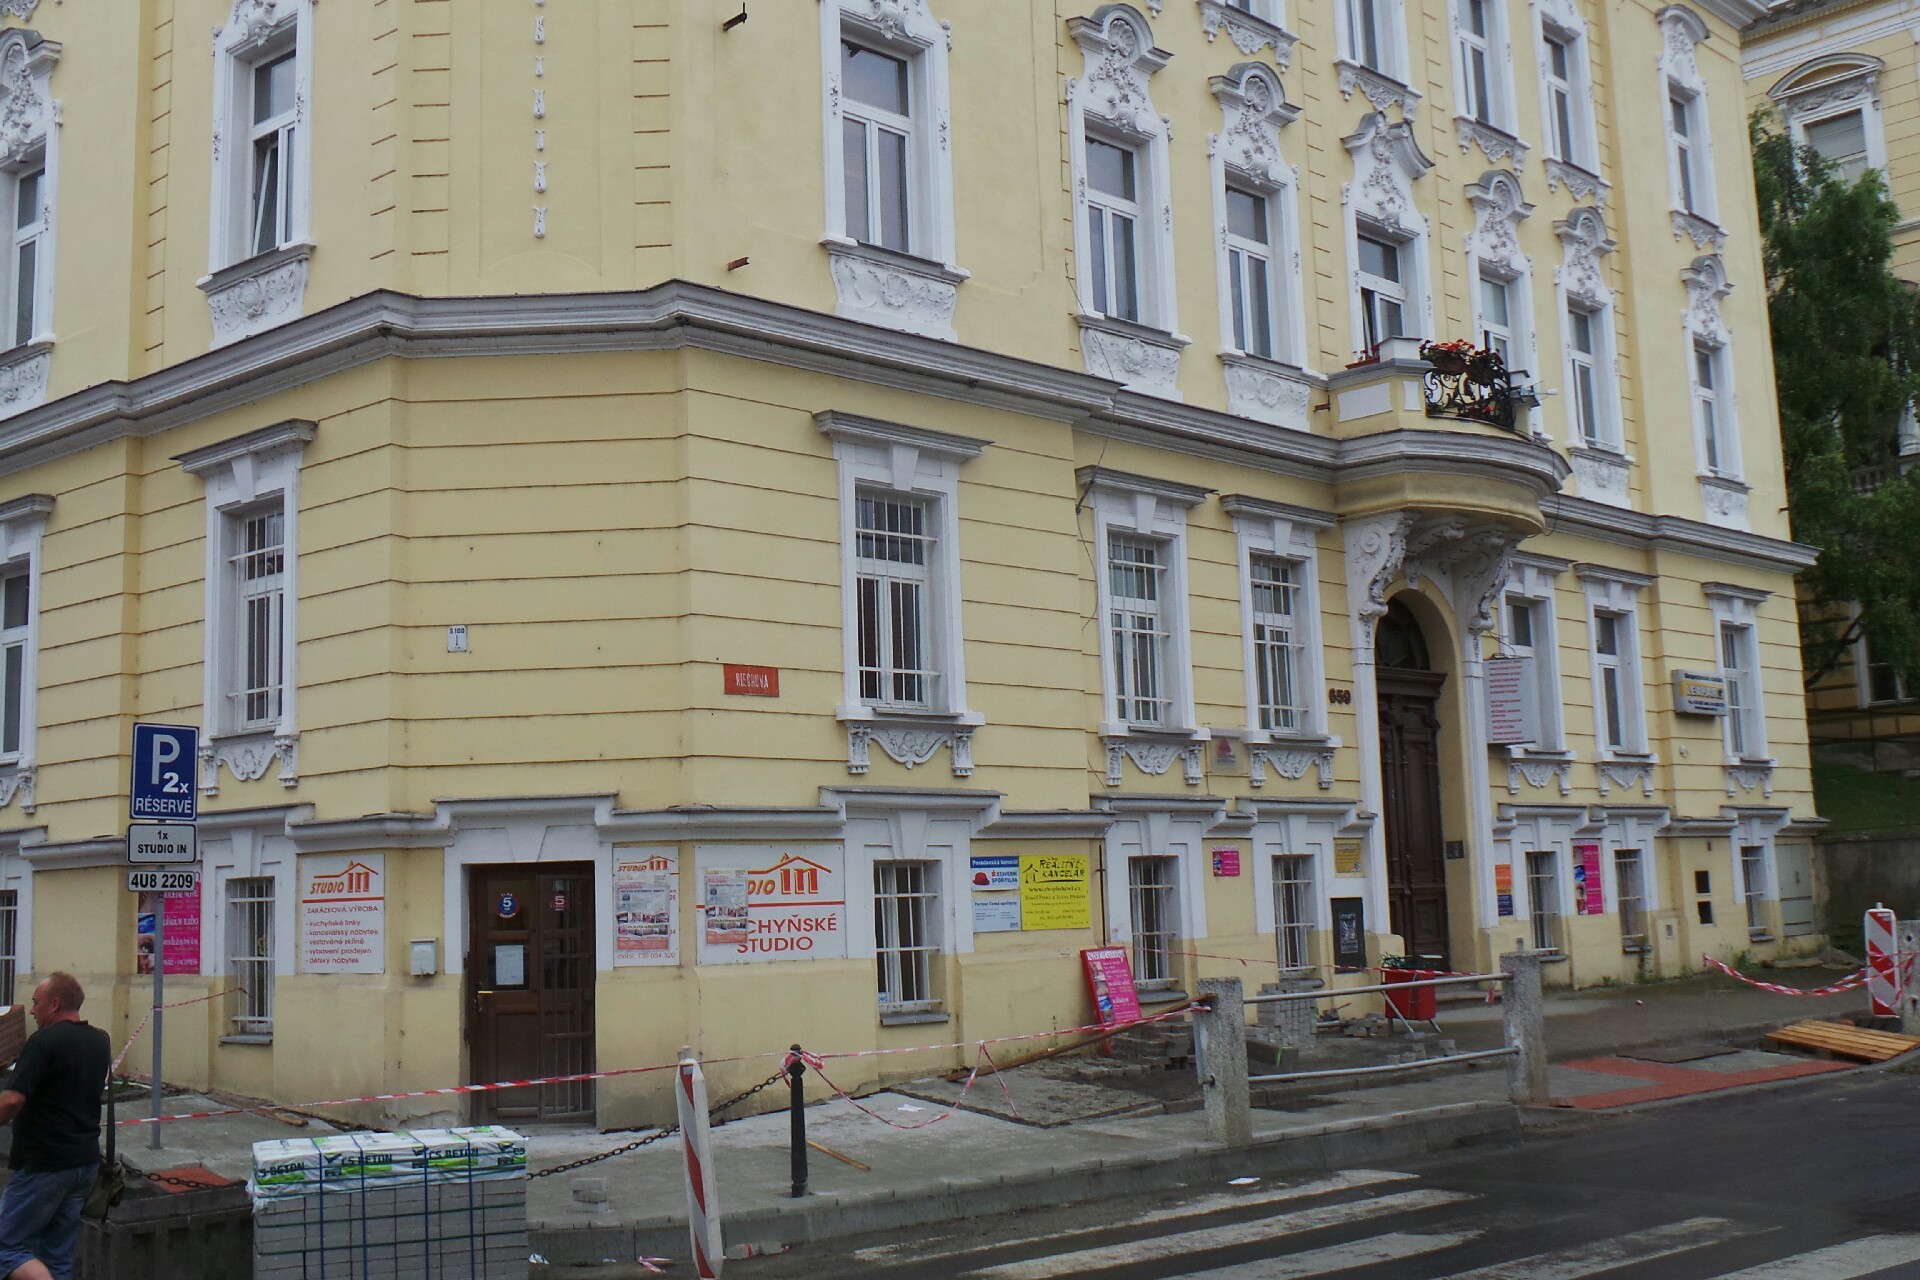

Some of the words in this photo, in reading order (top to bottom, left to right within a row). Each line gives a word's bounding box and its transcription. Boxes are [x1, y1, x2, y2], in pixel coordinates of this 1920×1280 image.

[151, 733, 180, 785] P
[162, 771, 189, 793] 2x
[135, 795, 192, 813] RÉSERVÉ
[157, 830, 168, 840] 1x
[137, 843, 174, 853] STUDIO
[176, 844, 187, 853] IN
[617, 864, 647, 872] STUDIO
[130, 873, 157, 888] 4U8
[161, 873, 193, 888] 2209
[310, 881, 345, 894] STUDIO
[307, 904, 347, 914] ZAKÁZKOVÁ
[348, 904, 378, 912] VÝROBA
[309, 919, 343, 927] kuchyňské
[747, 913, 837, 934] CHYŇSKÉ
[340, 947, 372, 955] prodejen
[737, 936, 813, 954] STUDIO
